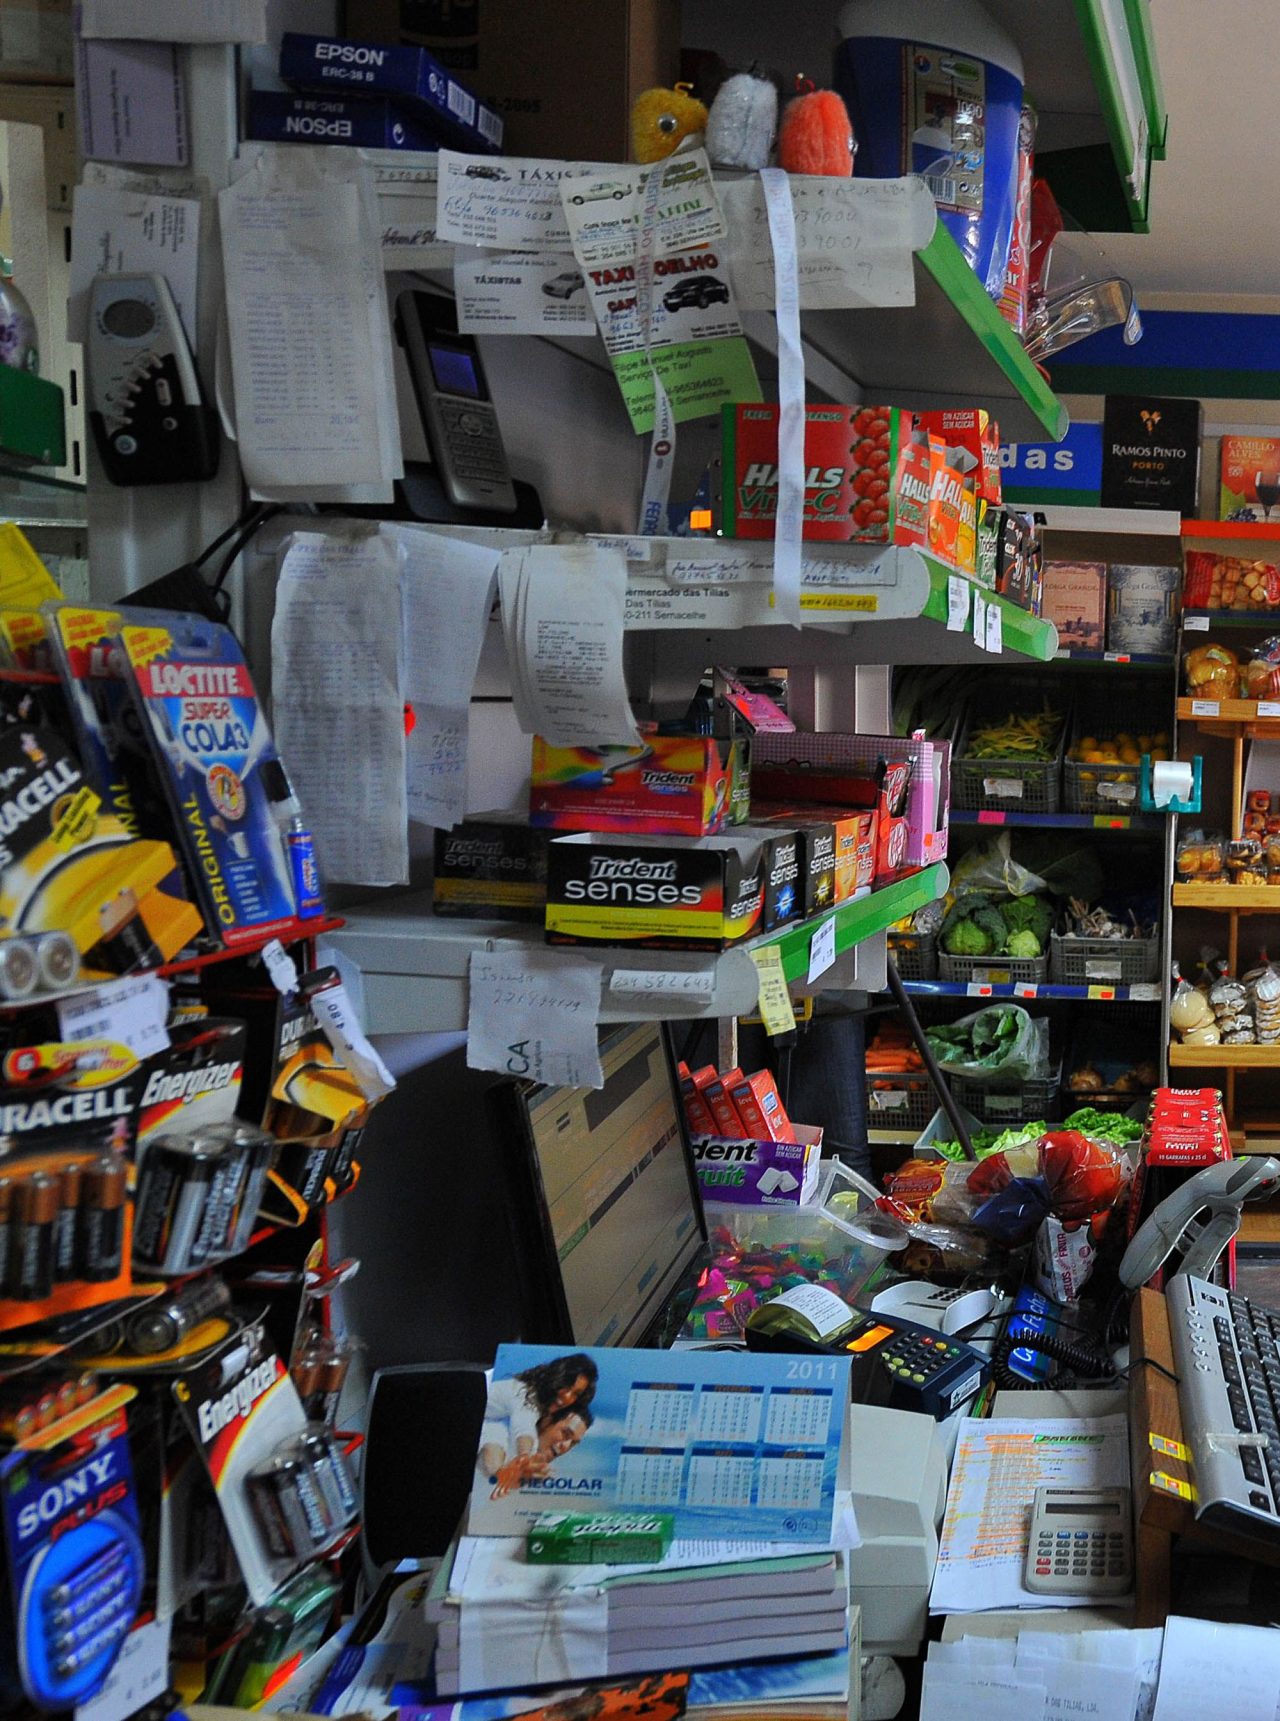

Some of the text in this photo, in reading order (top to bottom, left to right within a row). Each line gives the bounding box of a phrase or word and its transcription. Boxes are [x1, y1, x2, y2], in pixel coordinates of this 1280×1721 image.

[314, 43, 385, 66] EPSON
[285, 116, 352, 137] EPSON
[588, 265, 636, 287] TAXI
[653, 253, 720, 277] OELHO
[1111, 444, 1187, 459] RAMOS PINTO
[743, 463, 845, 489] HLS
[1132, 461, 1165, 471] PORTO
[930, 469, 962, 506] HALL
[625, 588, 681, 598] ermercado
[683, 588, 701, 598] das
[150, 664, 240, 694] LOCTITE
[183, 702, 231, 721] SUPER
[641, 771, 695, 785] Trident
[183, 792, 236, 925] ORIGINAL
[590, 856, 678, 881] Trident
[810, 853, 836, 875] senses
[564, 878, 702, 905] senses
[730, 895, 762, 919] senses
[139, 1060, 241, 1107] Energizer
[0, 1087, 134, 1133] RACELL
[691, 1138, 758, 1162] dent
[696, 1163, 746, 1187] ruit
[786, 1360, 838, 1381] 2011
[198, 1353, 278, 1444] Energizer
[17, 1451, 116, 1540] SONY
